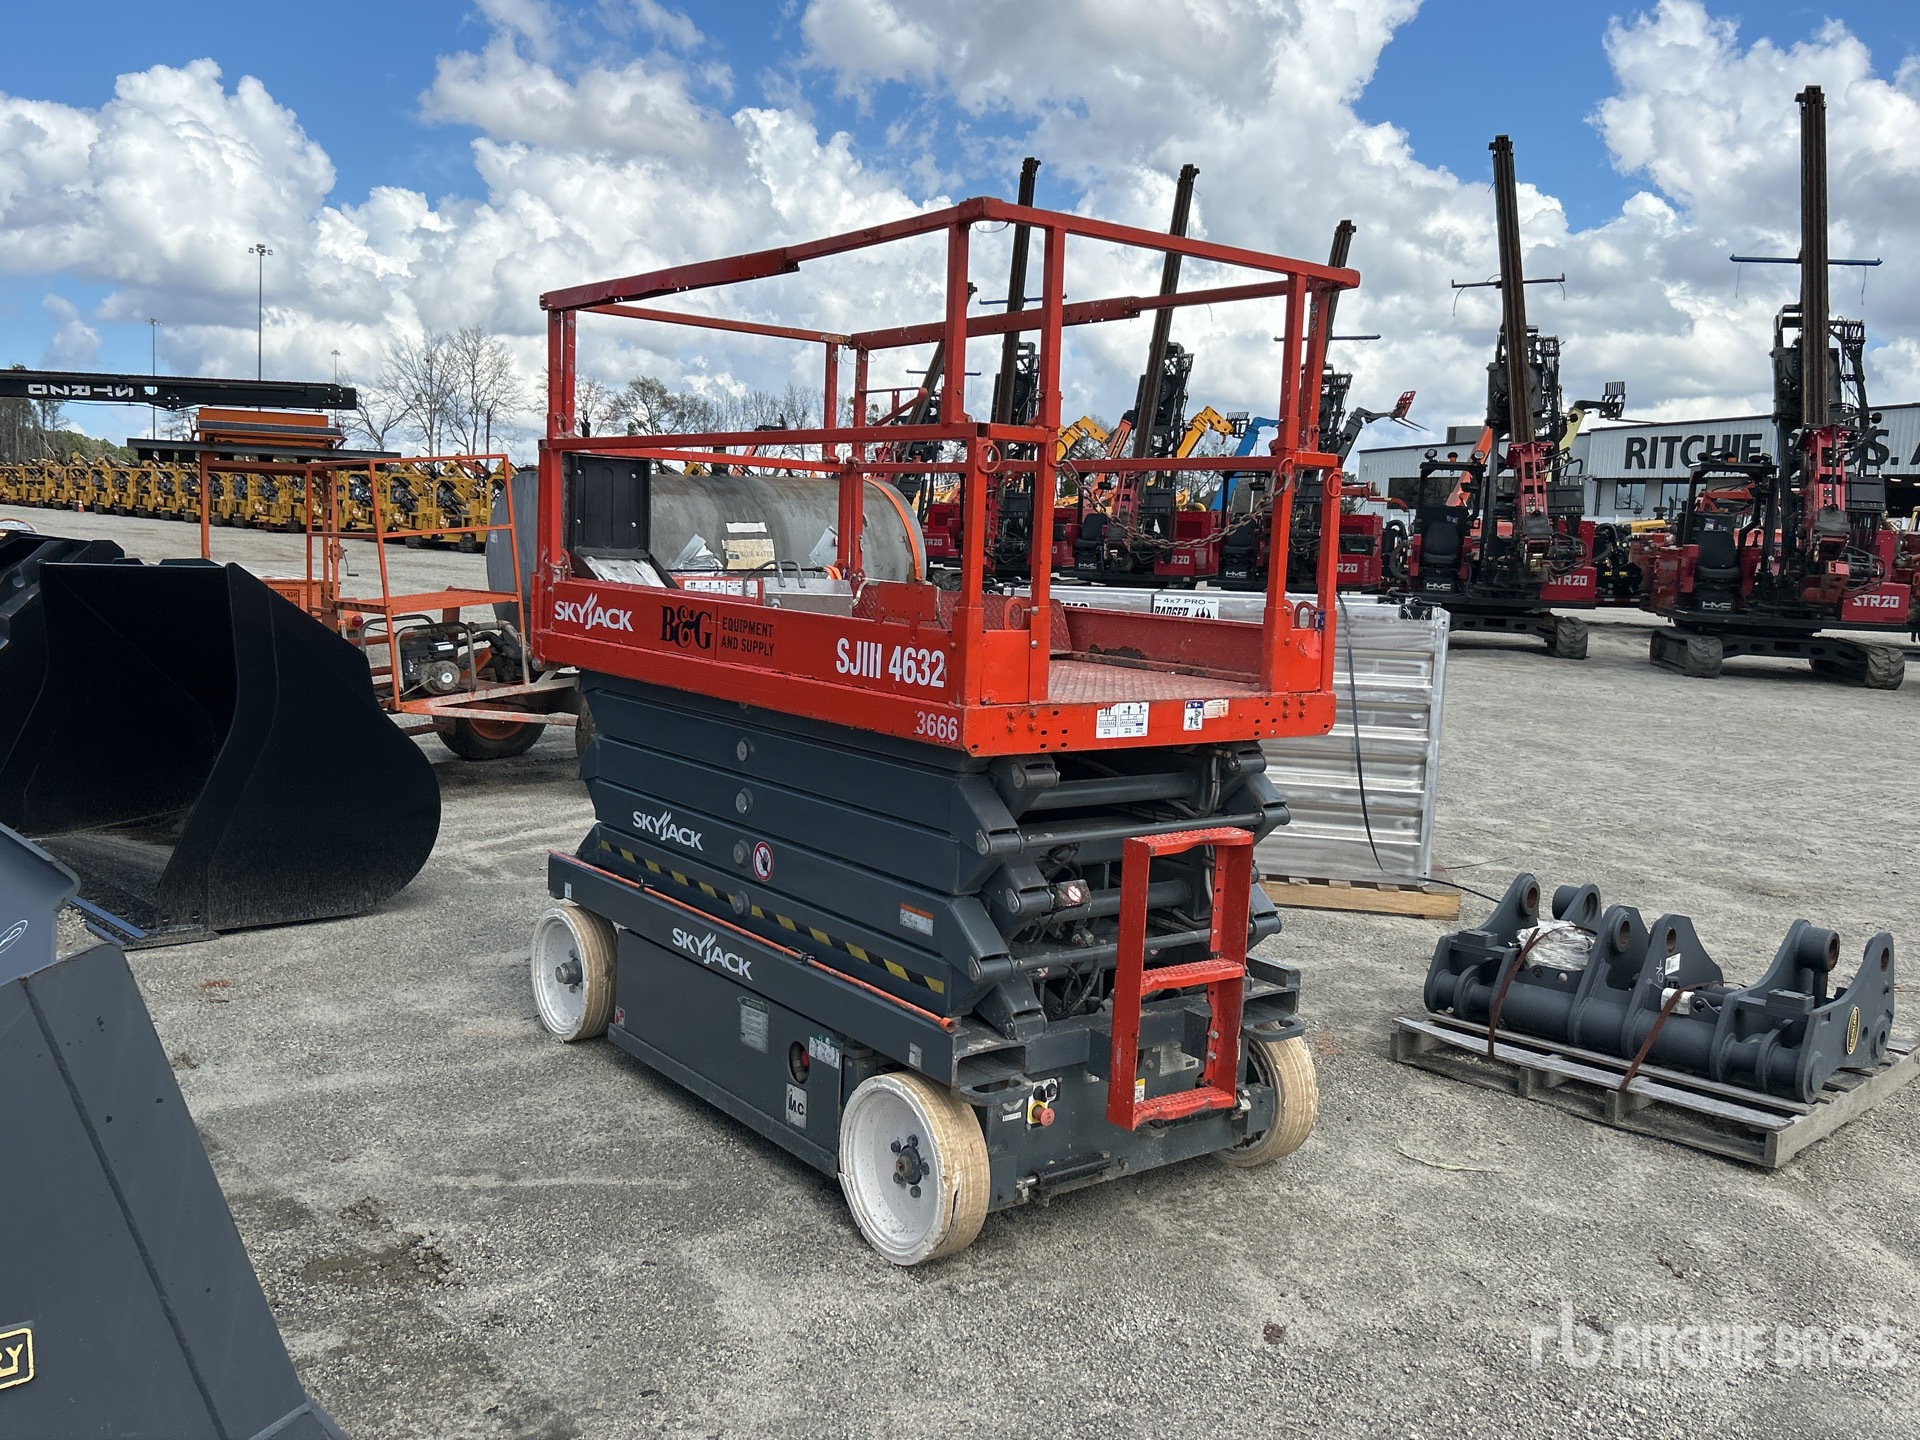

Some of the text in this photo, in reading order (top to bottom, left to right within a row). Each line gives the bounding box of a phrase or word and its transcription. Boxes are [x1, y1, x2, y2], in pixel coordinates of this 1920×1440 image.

[1624, 433, 1763, 470] RITCHIE
[554, 592, 634, 632] SKYJACK
[1852, 594, 1900, 609] STR20
[660, 605, 712, 650] B&G
[721, 635, 775, 658] AND SUPPLY
[722, 617, 774, 638] EQUIPMENT
[836, 637, 946, 688] SJIII 4632
[916, 710, 958, 741] 3666
[632, 810, 704, 851] SKYJACK
[672, 927, 753, 981] SKYJACK
